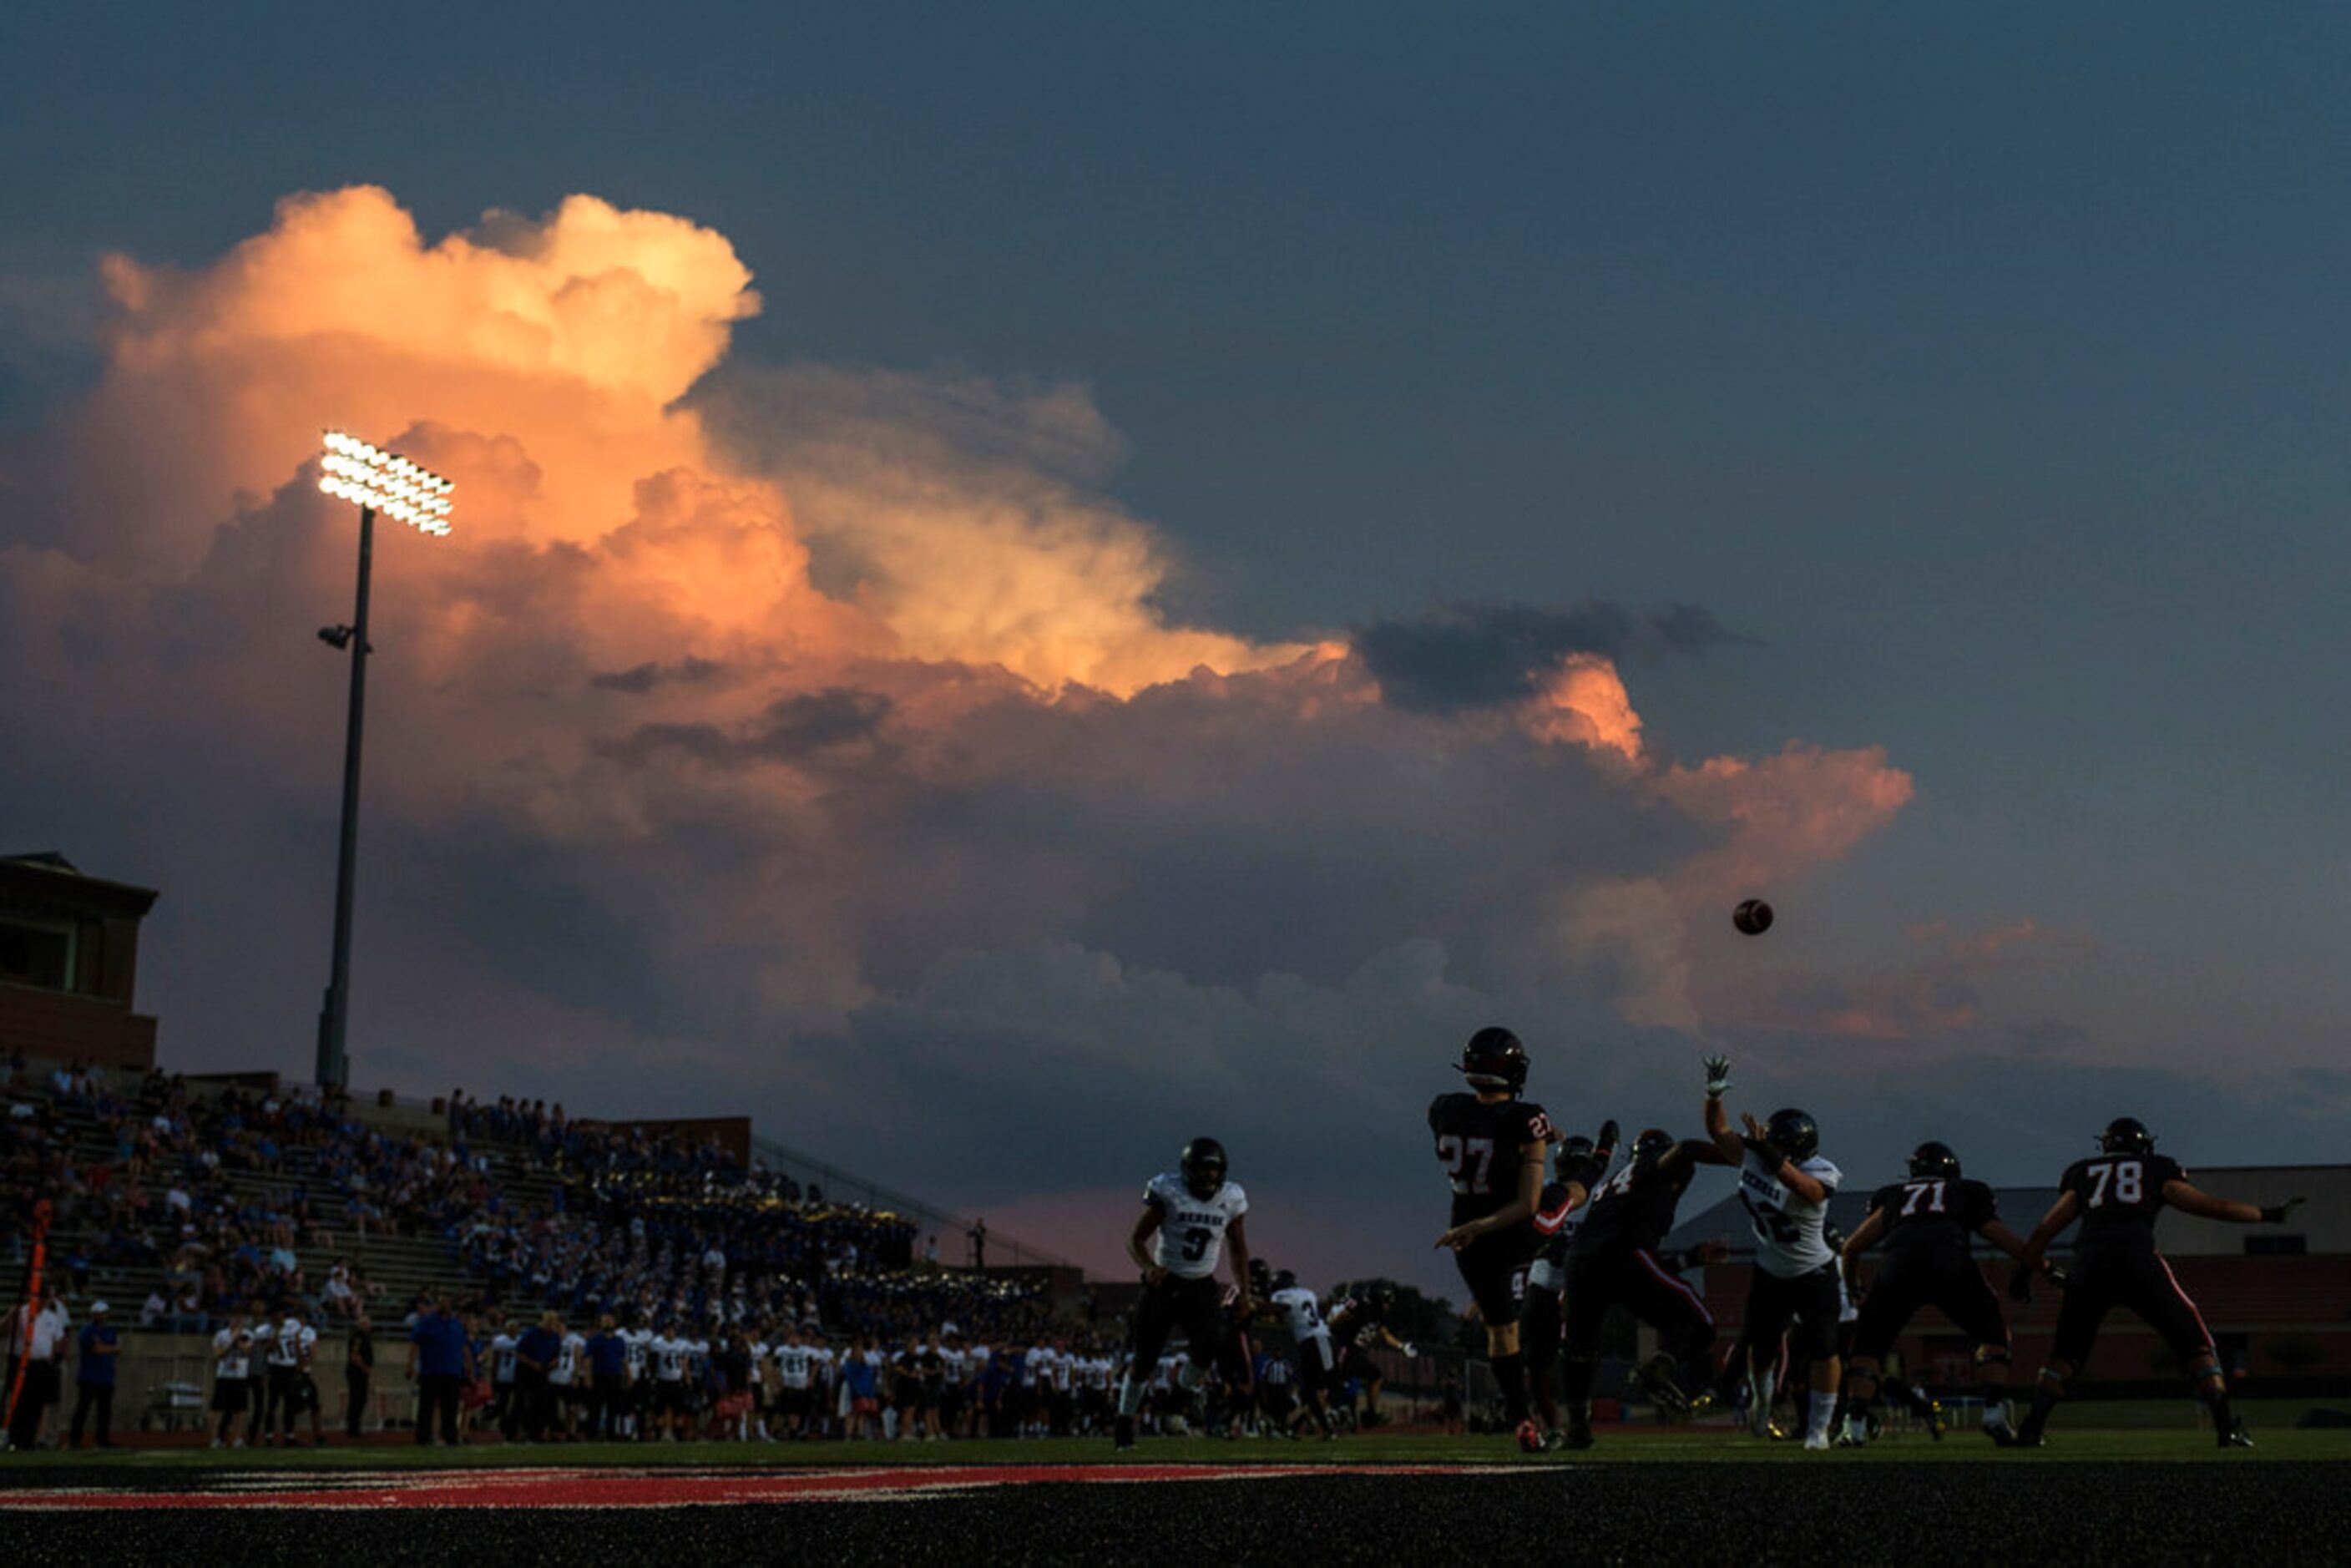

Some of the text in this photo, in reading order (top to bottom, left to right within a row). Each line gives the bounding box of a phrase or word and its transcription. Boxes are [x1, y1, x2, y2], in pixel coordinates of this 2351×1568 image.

[1438, 1134, 1494, 1195] 27
[2087, 1160, 2144, 1209] 78
[1899, 1181, 1947, 1216] 71
[1302, 1301, 1319, 1327] 3
